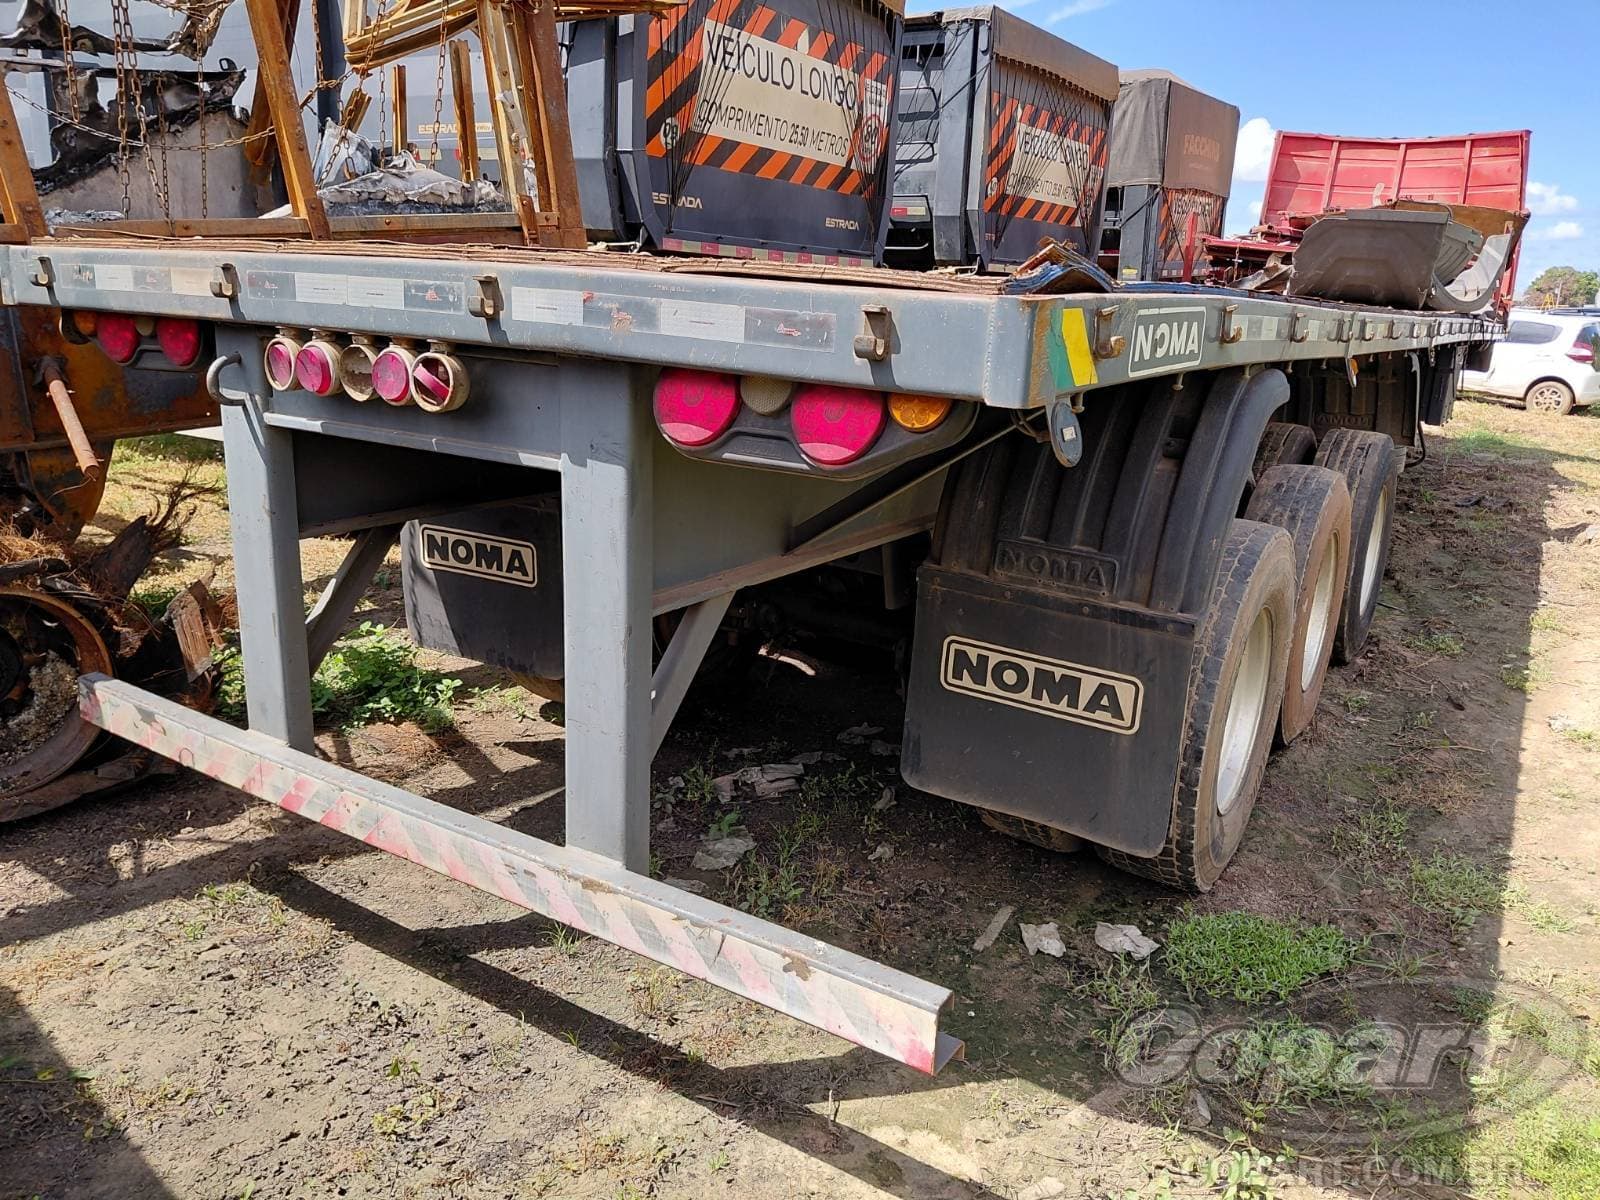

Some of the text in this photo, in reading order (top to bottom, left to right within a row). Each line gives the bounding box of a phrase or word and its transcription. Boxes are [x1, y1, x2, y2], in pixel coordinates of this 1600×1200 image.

[800, 63, 858, 110] LONGO
[698, 99, 789, 142] COMPRIMENTO
[810, 128, 849, 158] METROS
[652, 191, 703, 209] ESTADA
[825, 217, 860, 231] ESTRADA
[1133, 321, 1199, 362] NOMA
[426, 533, 530, 577] NOMA
[951, 648, 1125, 722] NOMA
